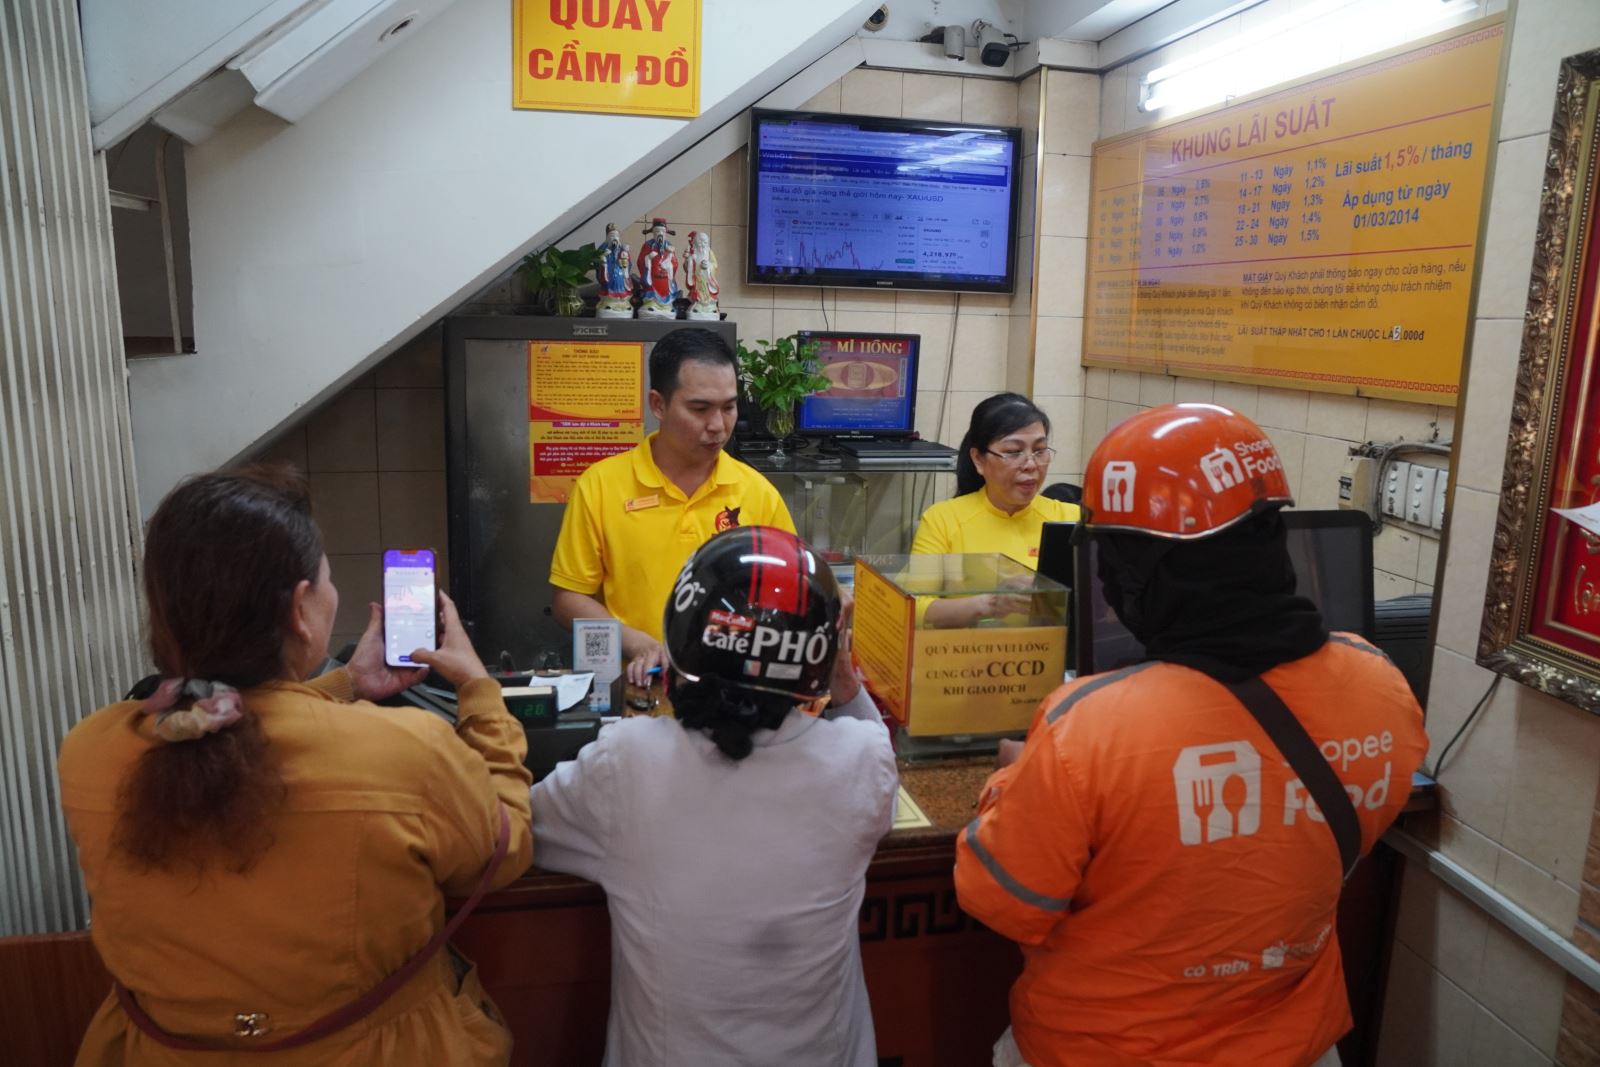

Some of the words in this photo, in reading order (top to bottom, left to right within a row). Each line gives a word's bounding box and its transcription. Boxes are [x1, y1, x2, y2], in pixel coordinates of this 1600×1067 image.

[528, 40, 621, 84] CẦM
[635, 46, 689, 88] ĐỒ
[1171, 126, 1231, 164] KHUNG
[1237, 112, 1268, 148] LÃI
[1335, 161, 1353, 177] Lãi
[1384, 145, 1420, 171] 1,5%
[1431, 141, 1473, 161] tháng
[1342, 189, 1359, 210] Áp
[1362, 190, 1394, 208] dụng
[1416, 179, 1451, 201] ngày
[1353, 208, 1420, 229] 01/03/2014
[1385, 265, 1400, 276] cho
[1308, 328, 1325, 337] CHO
[1327, 329, 1330, 337] 1
[702, 625, 750, 653] Café
[952, 642, 994, 654] KHÁCH
[996, 643, 1016, 653] VUI
[925, 669, 958, 680] CUNG
[986, 659, 1045, 678] CCCD
[943, 686, 964, 696] KHI
[967, 685, 996, 695] GIAO
[998, 684, 1026, 695] DỊCH
[1283, 730, 1393, 772] opee
